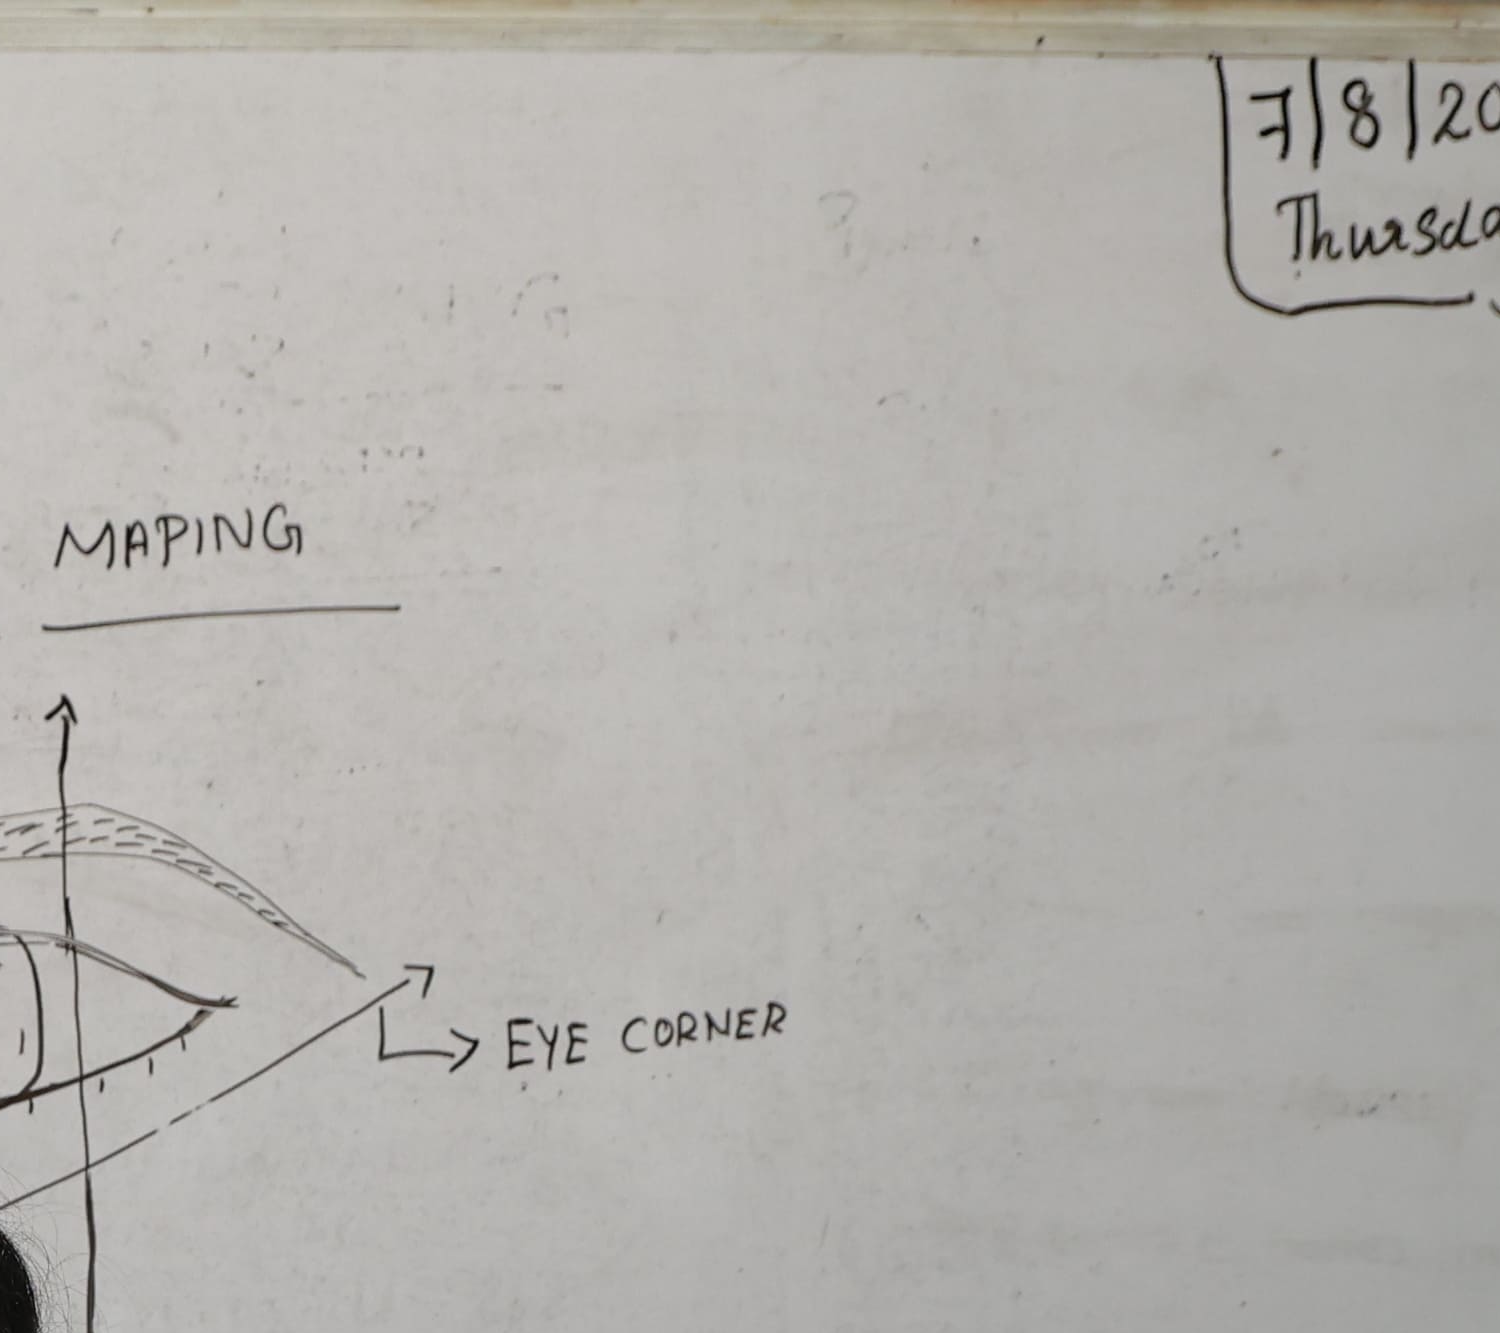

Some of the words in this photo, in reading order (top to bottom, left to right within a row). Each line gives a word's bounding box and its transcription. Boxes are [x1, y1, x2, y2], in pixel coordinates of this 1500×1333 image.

[54, 502, 304, 571] MAPING
[505, 1017, 589, 1072] EYE
[621, 1000, 788, 1055] CORNER
